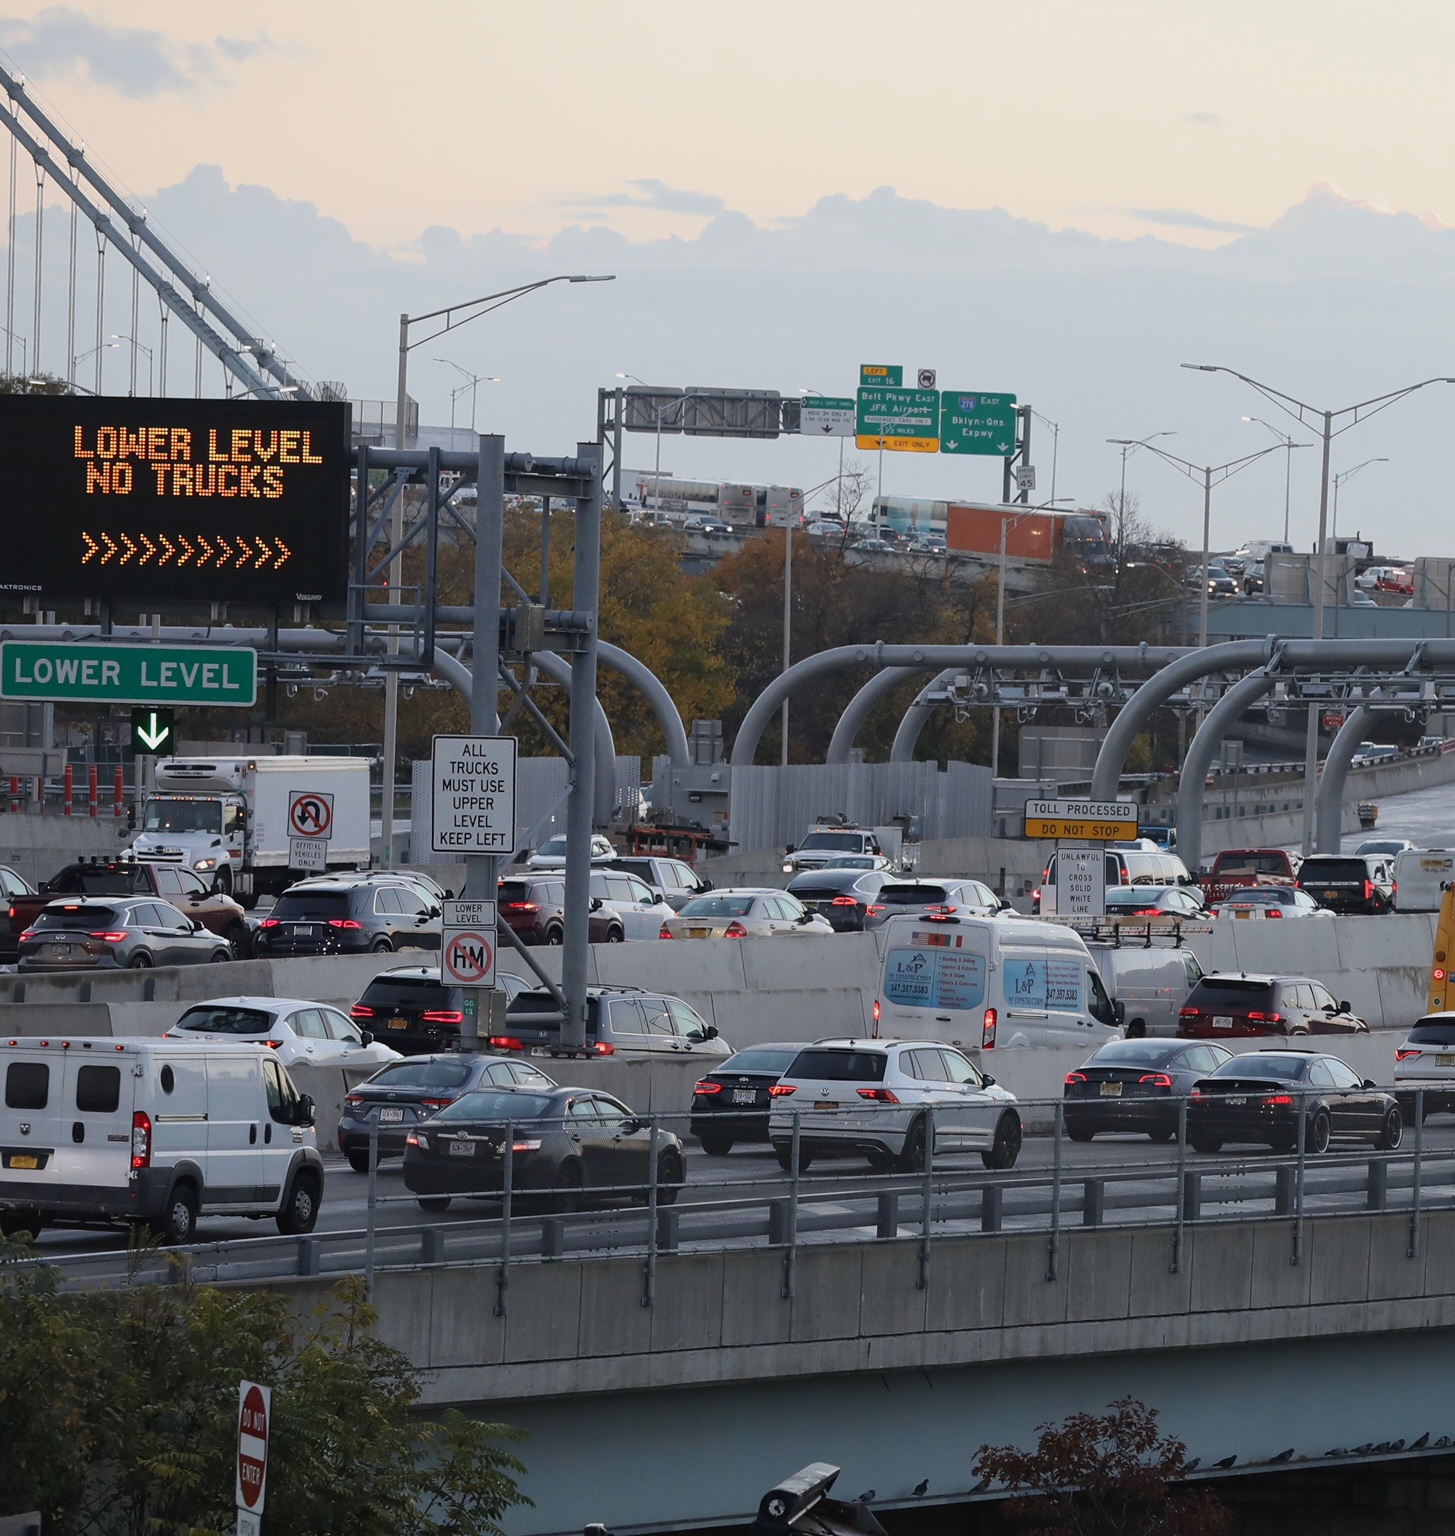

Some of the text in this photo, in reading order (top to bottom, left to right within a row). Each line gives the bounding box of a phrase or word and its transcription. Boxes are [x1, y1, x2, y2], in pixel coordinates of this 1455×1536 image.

[886, 376, 895, 385] 16
[862, 391, 935, 403] Belt Pkwy EAST
[961, 396, 999, 409] 278 EAST
[869, 404, 928, 415] JFK Airport
[962, 428, 993, 438] Expwy
[73, 425, 323, 464] LOWER LEVEL
[894, 440, 930, 449] EXIT ONLY
[86, 461, 284, 499] NO TRUCKS
[1020, 479, 1033, 488] 45
[14, 657, 240, 690] LOWER LEVEL
[462, 744, 487, 757] ALL
[450, 761, 499, 775] TRUCKS
[442, 779, 505, 793] MUST USE
[453, 797, 494, 810] UPPER
[1034, 803, 1130, 816] TOLL PROCESSED
[454, 815, 493, 828] LEVEL
[1041, 824, 1120, 836] DO NOT STOP
[440, 832, 506, 846] KEEP LEFT
[295, 842, 321, 850] OFFICIAL
[294, 851, 322, 859] VEHICLES
[1061, 853, 1100, 861] UNLAWFUL
[1068, 874, 1093, 882] CROSS
[1070, 884, 1092, 892] SOLID
[1070, 895, 1092, 903] WHITE
[455, 904, 482, 913] LOWER
[456, 915, 481, 923] LEVEL
[453, 946, 484, 969] HM
[890, 984, 929, 994] 347.357.5383
[243, 1408, 265, 1432] DO NOT
[242, 1462, 260, 1486] ENTER
